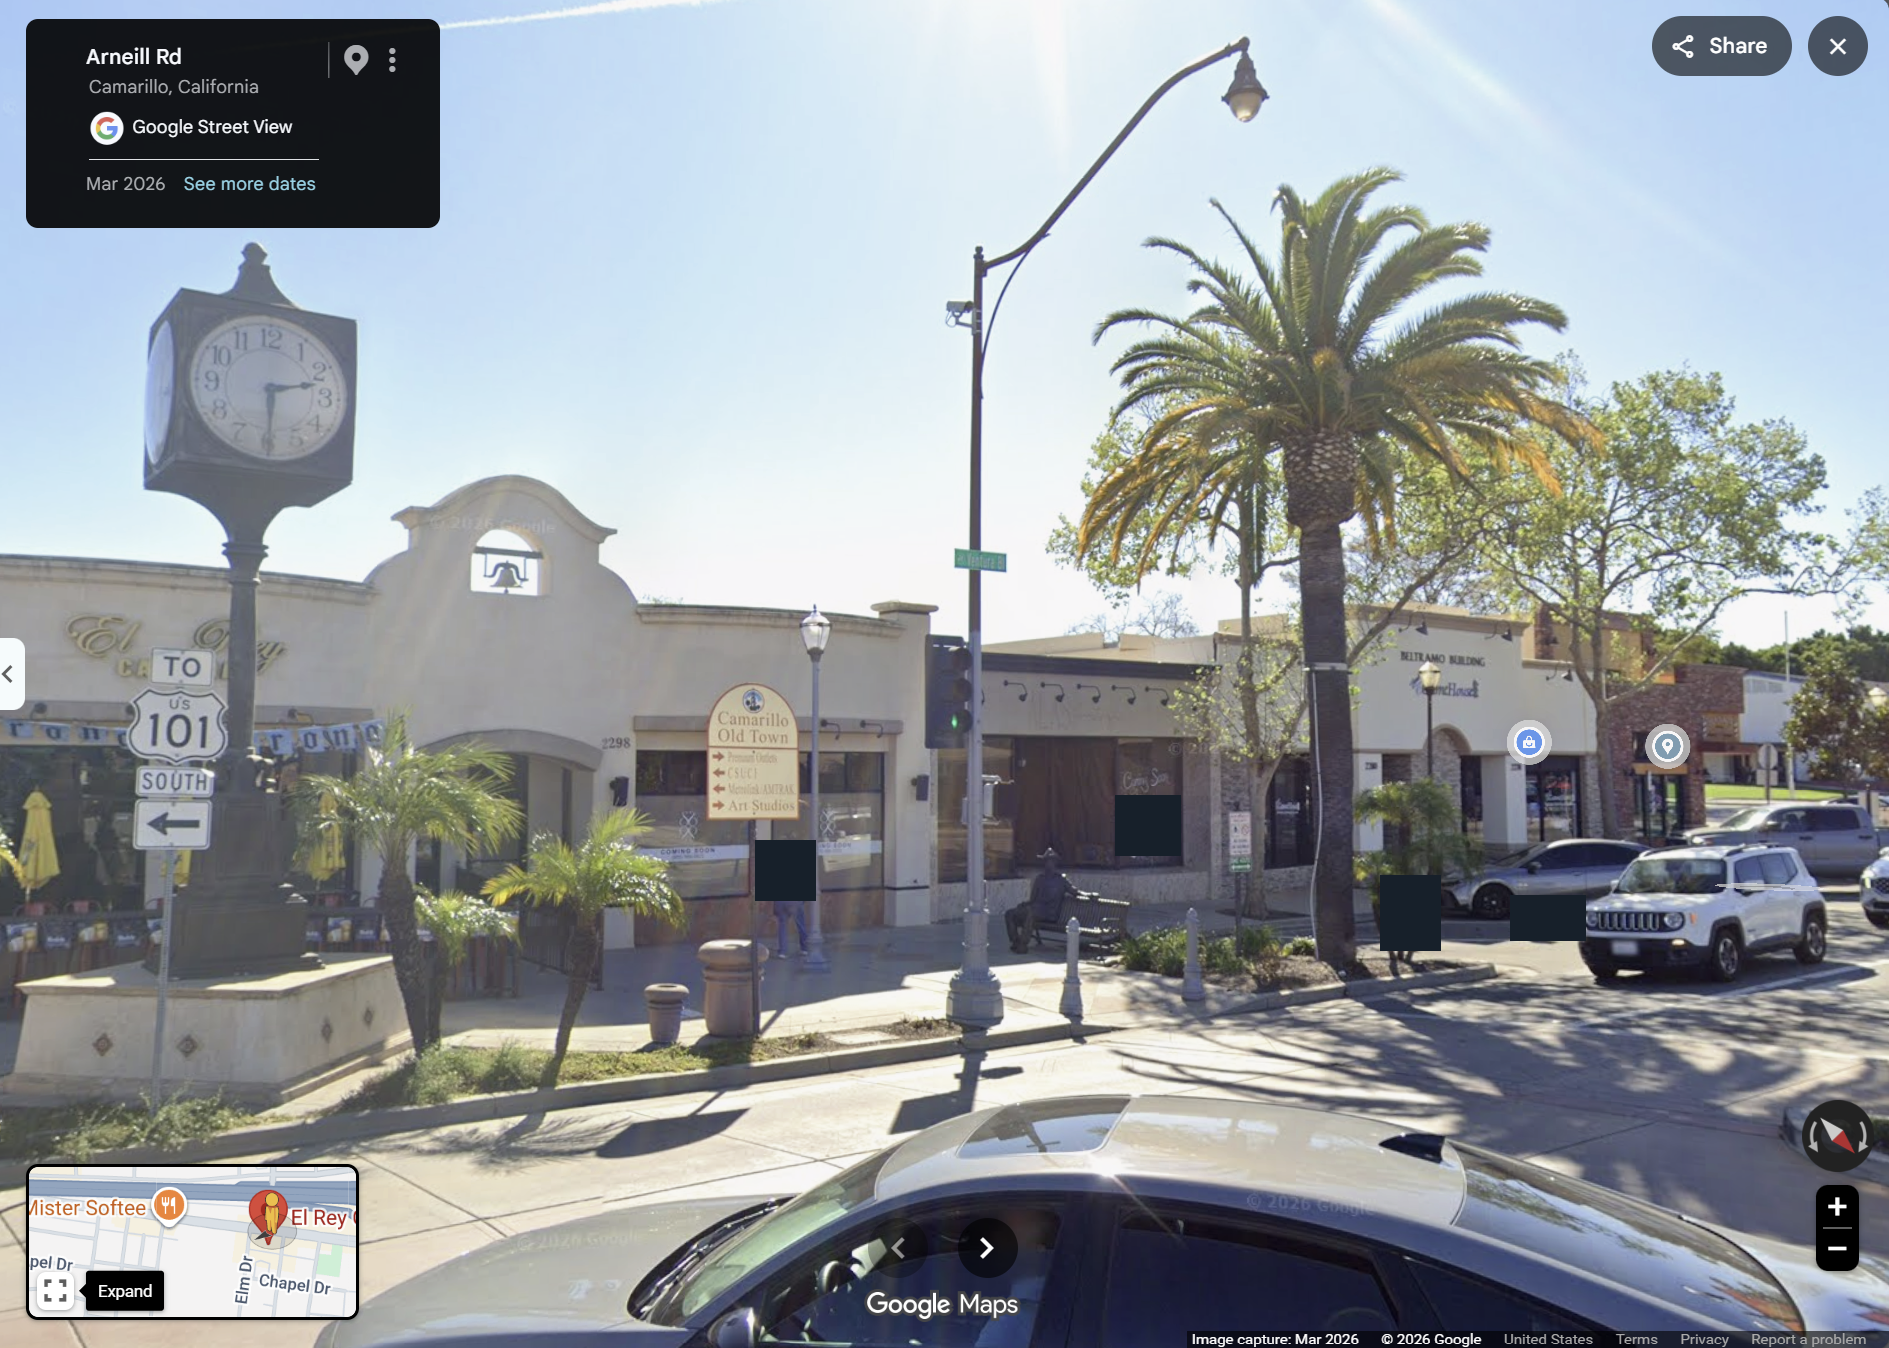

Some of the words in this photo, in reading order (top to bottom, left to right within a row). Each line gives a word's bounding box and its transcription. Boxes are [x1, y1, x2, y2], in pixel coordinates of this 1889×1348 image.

[233, 330, 249, 350] 11
[260, 328, 283, 350] 12
[212, 345, 232, 366] 10
[297, 343, 305, 362] 1
[204, 370, 220, 391] 9
[311, 361, 327, 382] 2
[317, 387, 333, 408] 3
[211, 400, 228, 420] 8
[231, 422, 247, 443] 7
[306, 414, 321, 433] 4
[289, 428, 304, 449] 5
[67, 614, 140, 657] El
[193, 618, 286, 677] Ry
[164, 656, 202, 678] TO
[1400, 651, 1446, 664] BELTRAMO
[1449, 655, 1486, 667] BUILDING
[169, 699, 191, 711] US
[718, 711, 789, 728] Camarillo
[149, 712, 208, 750] 101
[718, 728, 745, 743] Old
[750, 729, 789, 744] Town
[601, 736, 631, 750] 2298
[142, 771, 208, 792] SOUTH
[728, 800, 748, 811] Art
[752, 799, 796, 812] Studios
